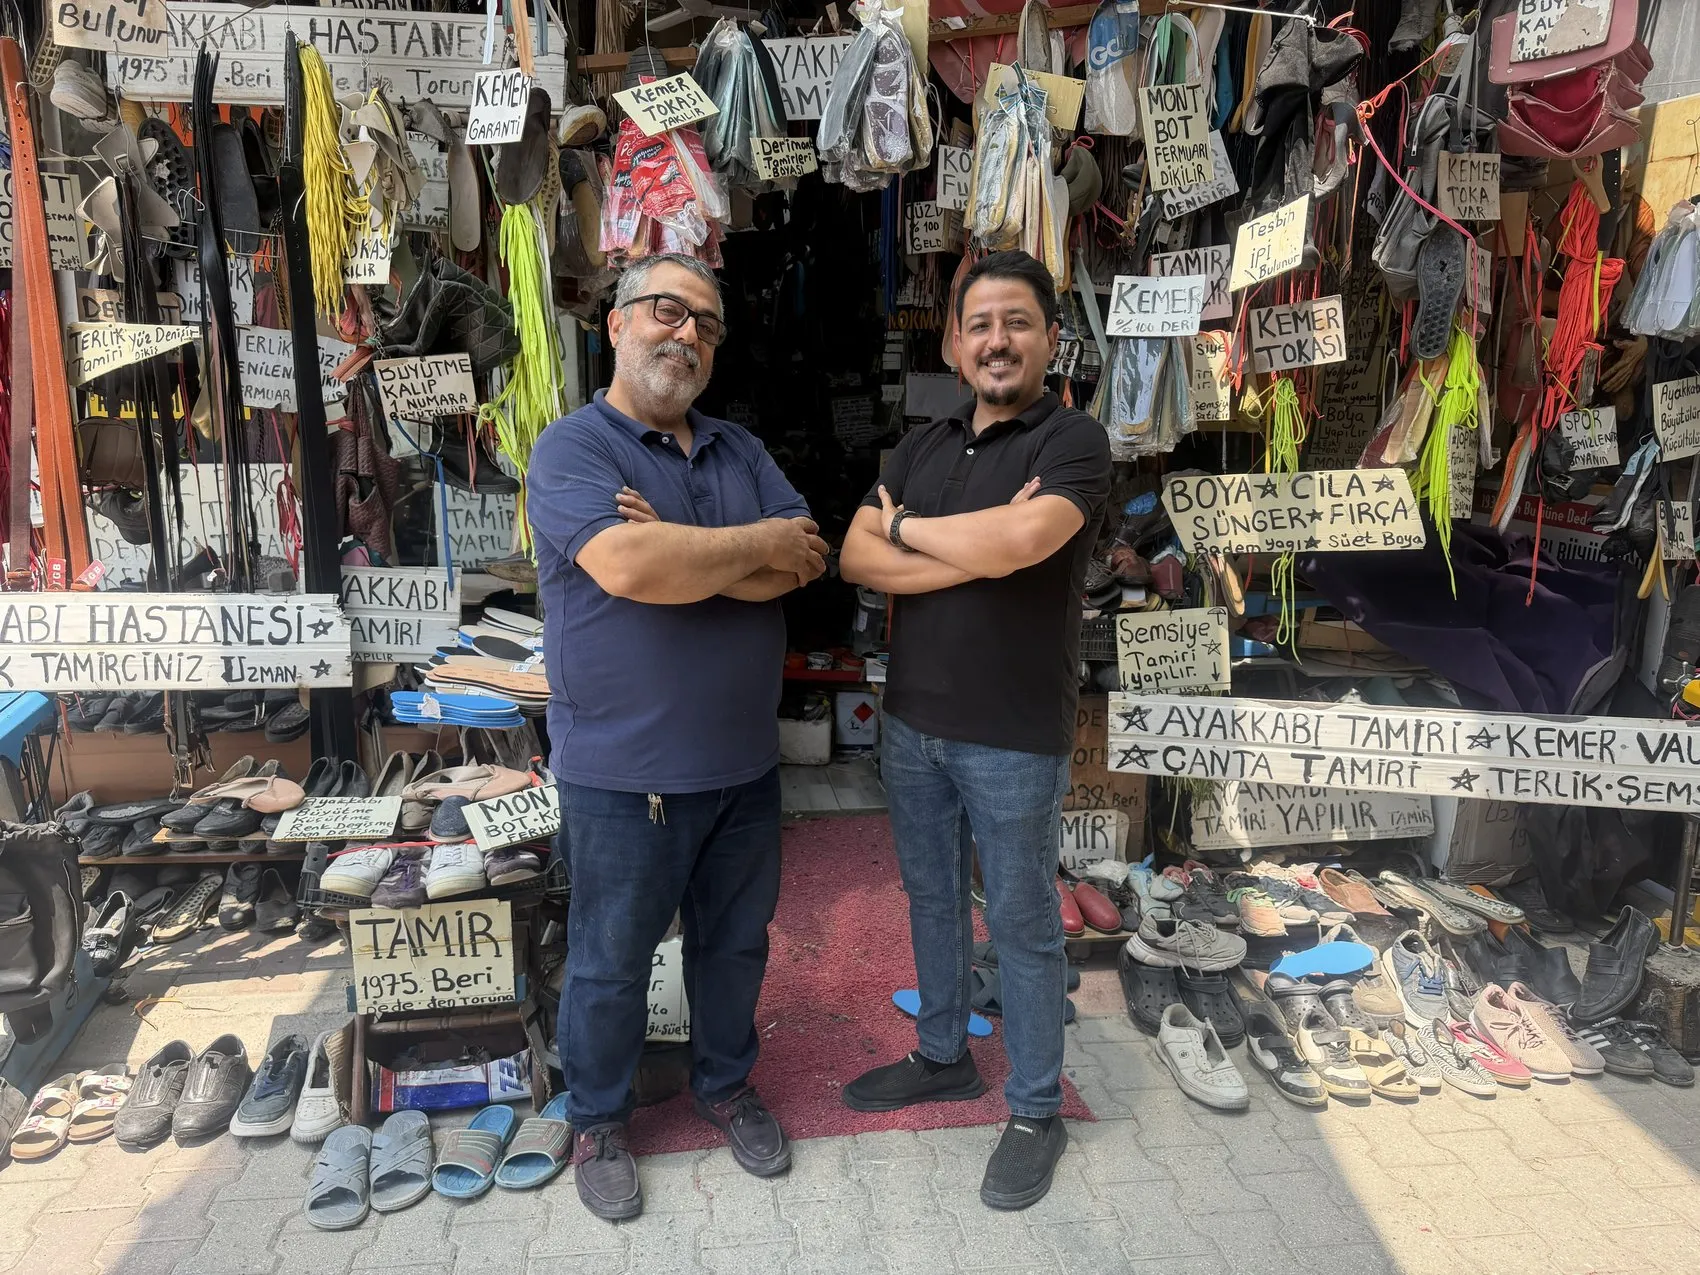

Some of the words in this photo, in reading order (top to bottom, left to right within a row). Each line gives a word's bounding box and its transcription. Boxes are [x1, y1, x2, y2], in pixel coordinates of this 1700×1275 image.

[58, 4, 168, 45] Bulunur
[630, 76, 690, 104] KEMER
[1147, 84, 1201, 115] MONT
[642, 91, 704, 122] TOKASI
[659, 108, 705, 131] TAKILIR
[1154, 115, 1194, 143] BOT
[1153, 143, 1209, 167] FERMUARI
[1448, 157, 1499, 182] KEMER
[1447, 186, 1491, 204] TOKA
[1457, 206, 1486, 218] VAR
[1112, 282, 1202, 315] KEMER
[1257, 306, 1340, 339] KEMER
[1254, 335, 1343, 368] TOKASI
[379, 357, 472, 382] BÜYÜTME
[382, 379, 437, 399] KALIP
[405, 392, 468, 411] NUMARA
[1170, 475, 1251, 513] BOYA
[1193, 506, 1308, 542] SÜNGER
[1330, 497, 1409, 526] FIRÇA
[1382, 531, 1424, 548] Boya
[86, 604, 305, 646] HASTANESİ
[1119, 616, 1211, 648] Şemsiye
[1124, 649, 1196, 671] Tamiri
[1156, 705, 1323, 750] AYAKKABI
[1506, 724, 1616, 764] KEMER
[1162, 745, 1273, 780] ÇANTA
[1489, 766, 1602, 802] TERLİK
[484, 816, 528, 837] BOT
[1276, 801, 1378, 835] YAPILIR
[355, 909, 503, 960] TAMİR
[432, 966, 493, 994] Beri
